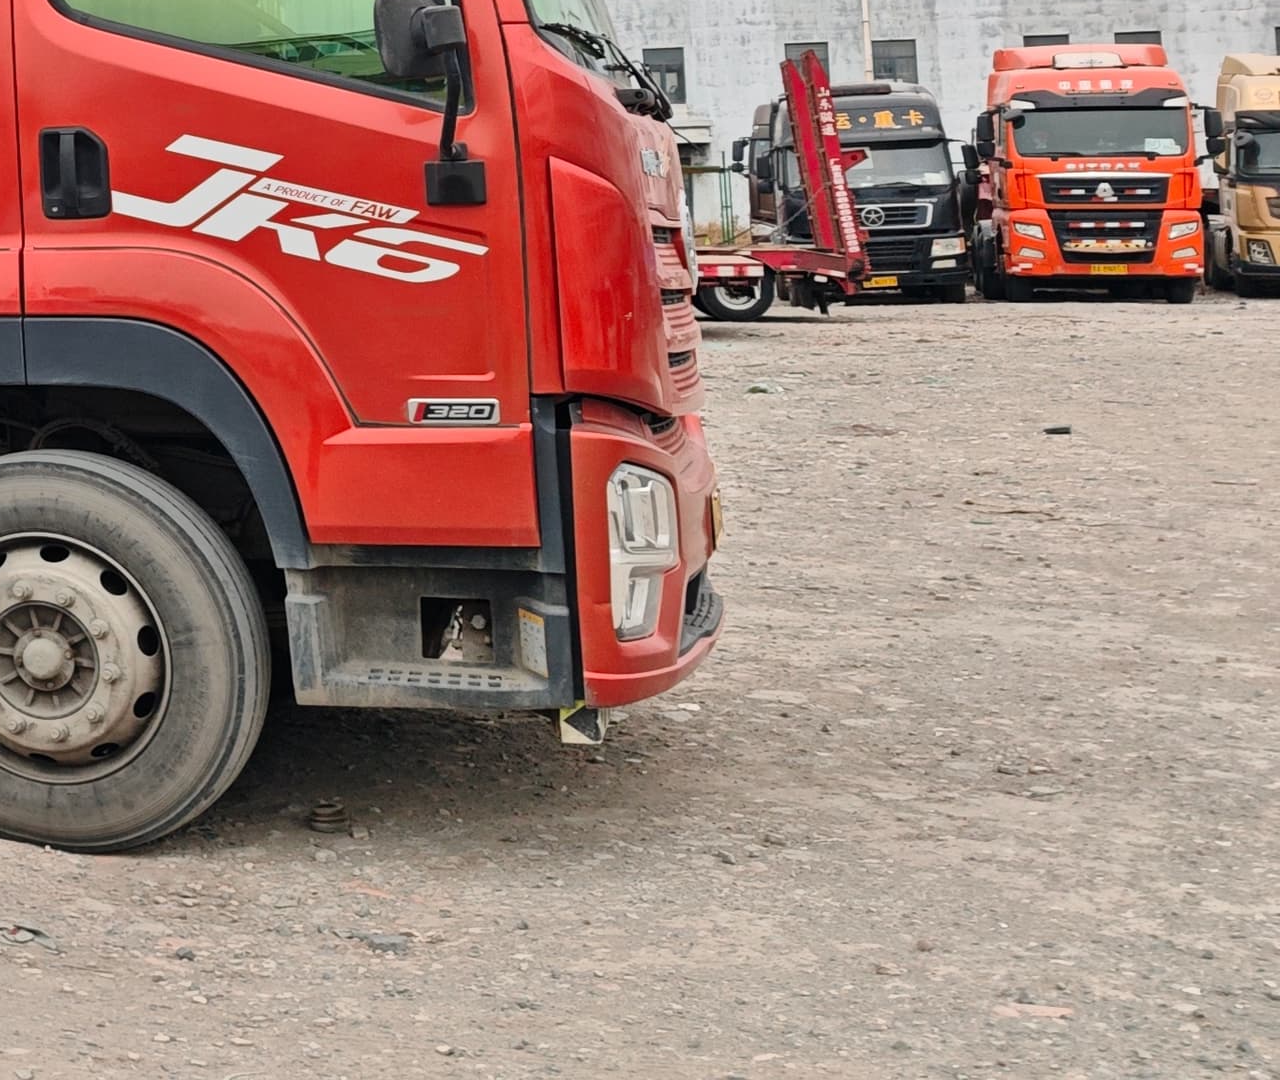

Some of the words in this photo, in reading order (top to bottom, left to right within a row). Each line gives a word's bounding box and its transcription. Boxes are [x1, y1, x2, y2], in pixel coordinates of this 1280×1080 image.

[263, 183, 272, 191] A
[273, 185, 329, 204] PRODUCT
[329, 197, 350, 208] OF
[349, 200, 401, 220] FAW
[425, 405, 492, 418] 320
